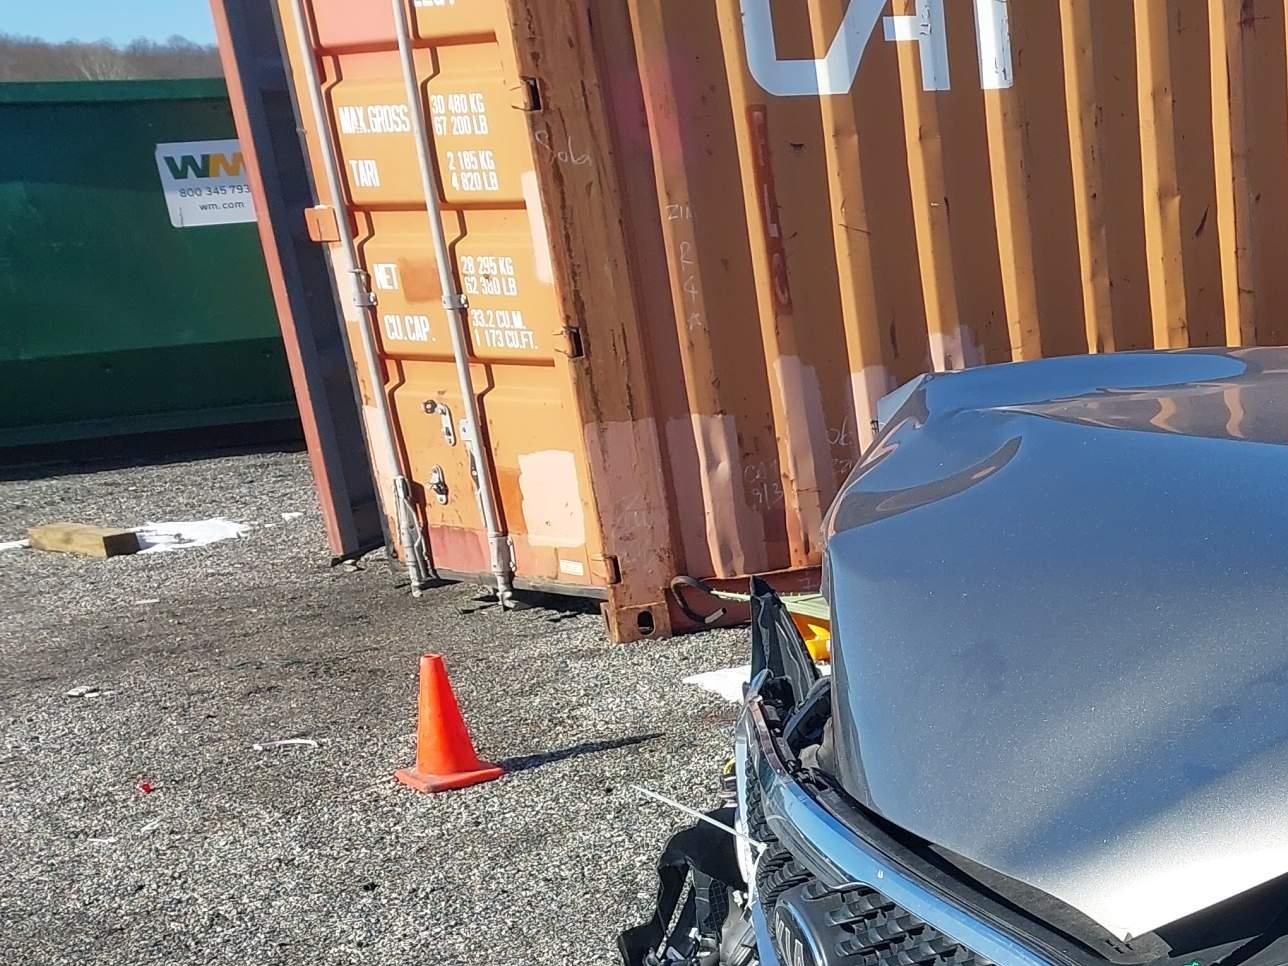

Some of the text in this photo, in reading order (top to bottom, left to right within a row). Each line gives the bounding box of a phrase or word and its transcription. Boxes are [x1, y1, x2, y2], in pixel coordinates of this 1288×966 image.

[431, 95, 445, 114] 30
[448, 93, 468, 114] 480
[469, 92, 485, 113] KG
[434, 115, 488, 136] 67 200 LB
[447, 151, 456, 170] 2
[458, 151, 476, 170] 185
[479, 150, 495, 170] KG
[451, 171, 498, 191] 4 820 LB
[179, 187, 203, 198] 800
[206, 185, 227, 197] 345
[373, 256, 514, 290] NET 28 295 KG
[464, 276, 479, 294] 62
[502, 276, 517, 296] LB
[471, 309, 494, 328] 33.2
[475, 329, 481, 347] 1
[485, 329, 504, 347] 173
